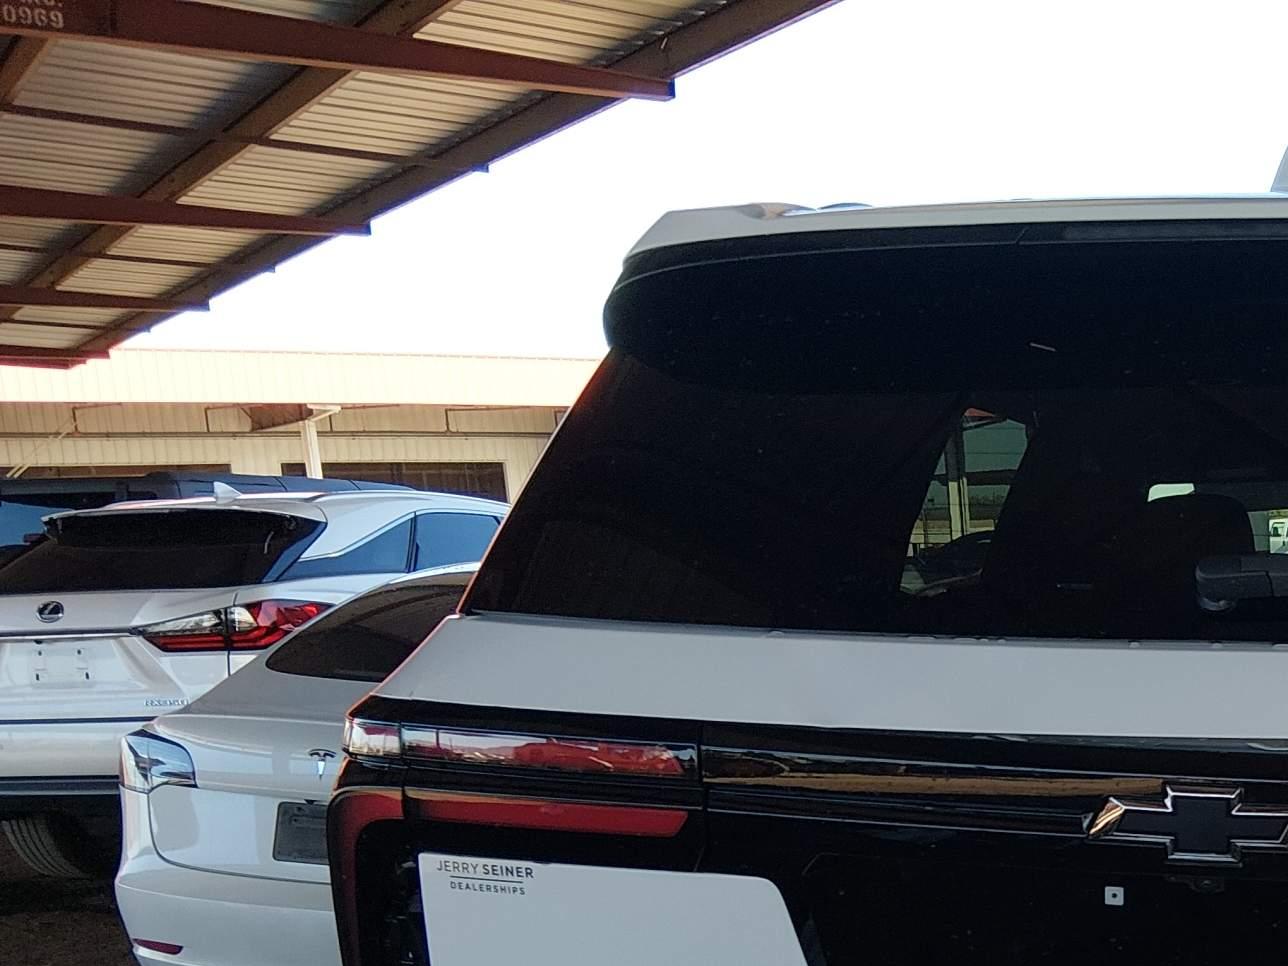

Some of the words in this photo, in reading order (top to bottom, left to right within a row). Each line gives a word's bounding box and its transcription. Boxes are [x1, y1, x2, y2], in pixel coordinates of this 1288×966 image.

[437, 860, 478, 874] JERRY
[482, 864, 534, 878] SEINER
[450, 881, 525, 895] DEALERSHIPS
